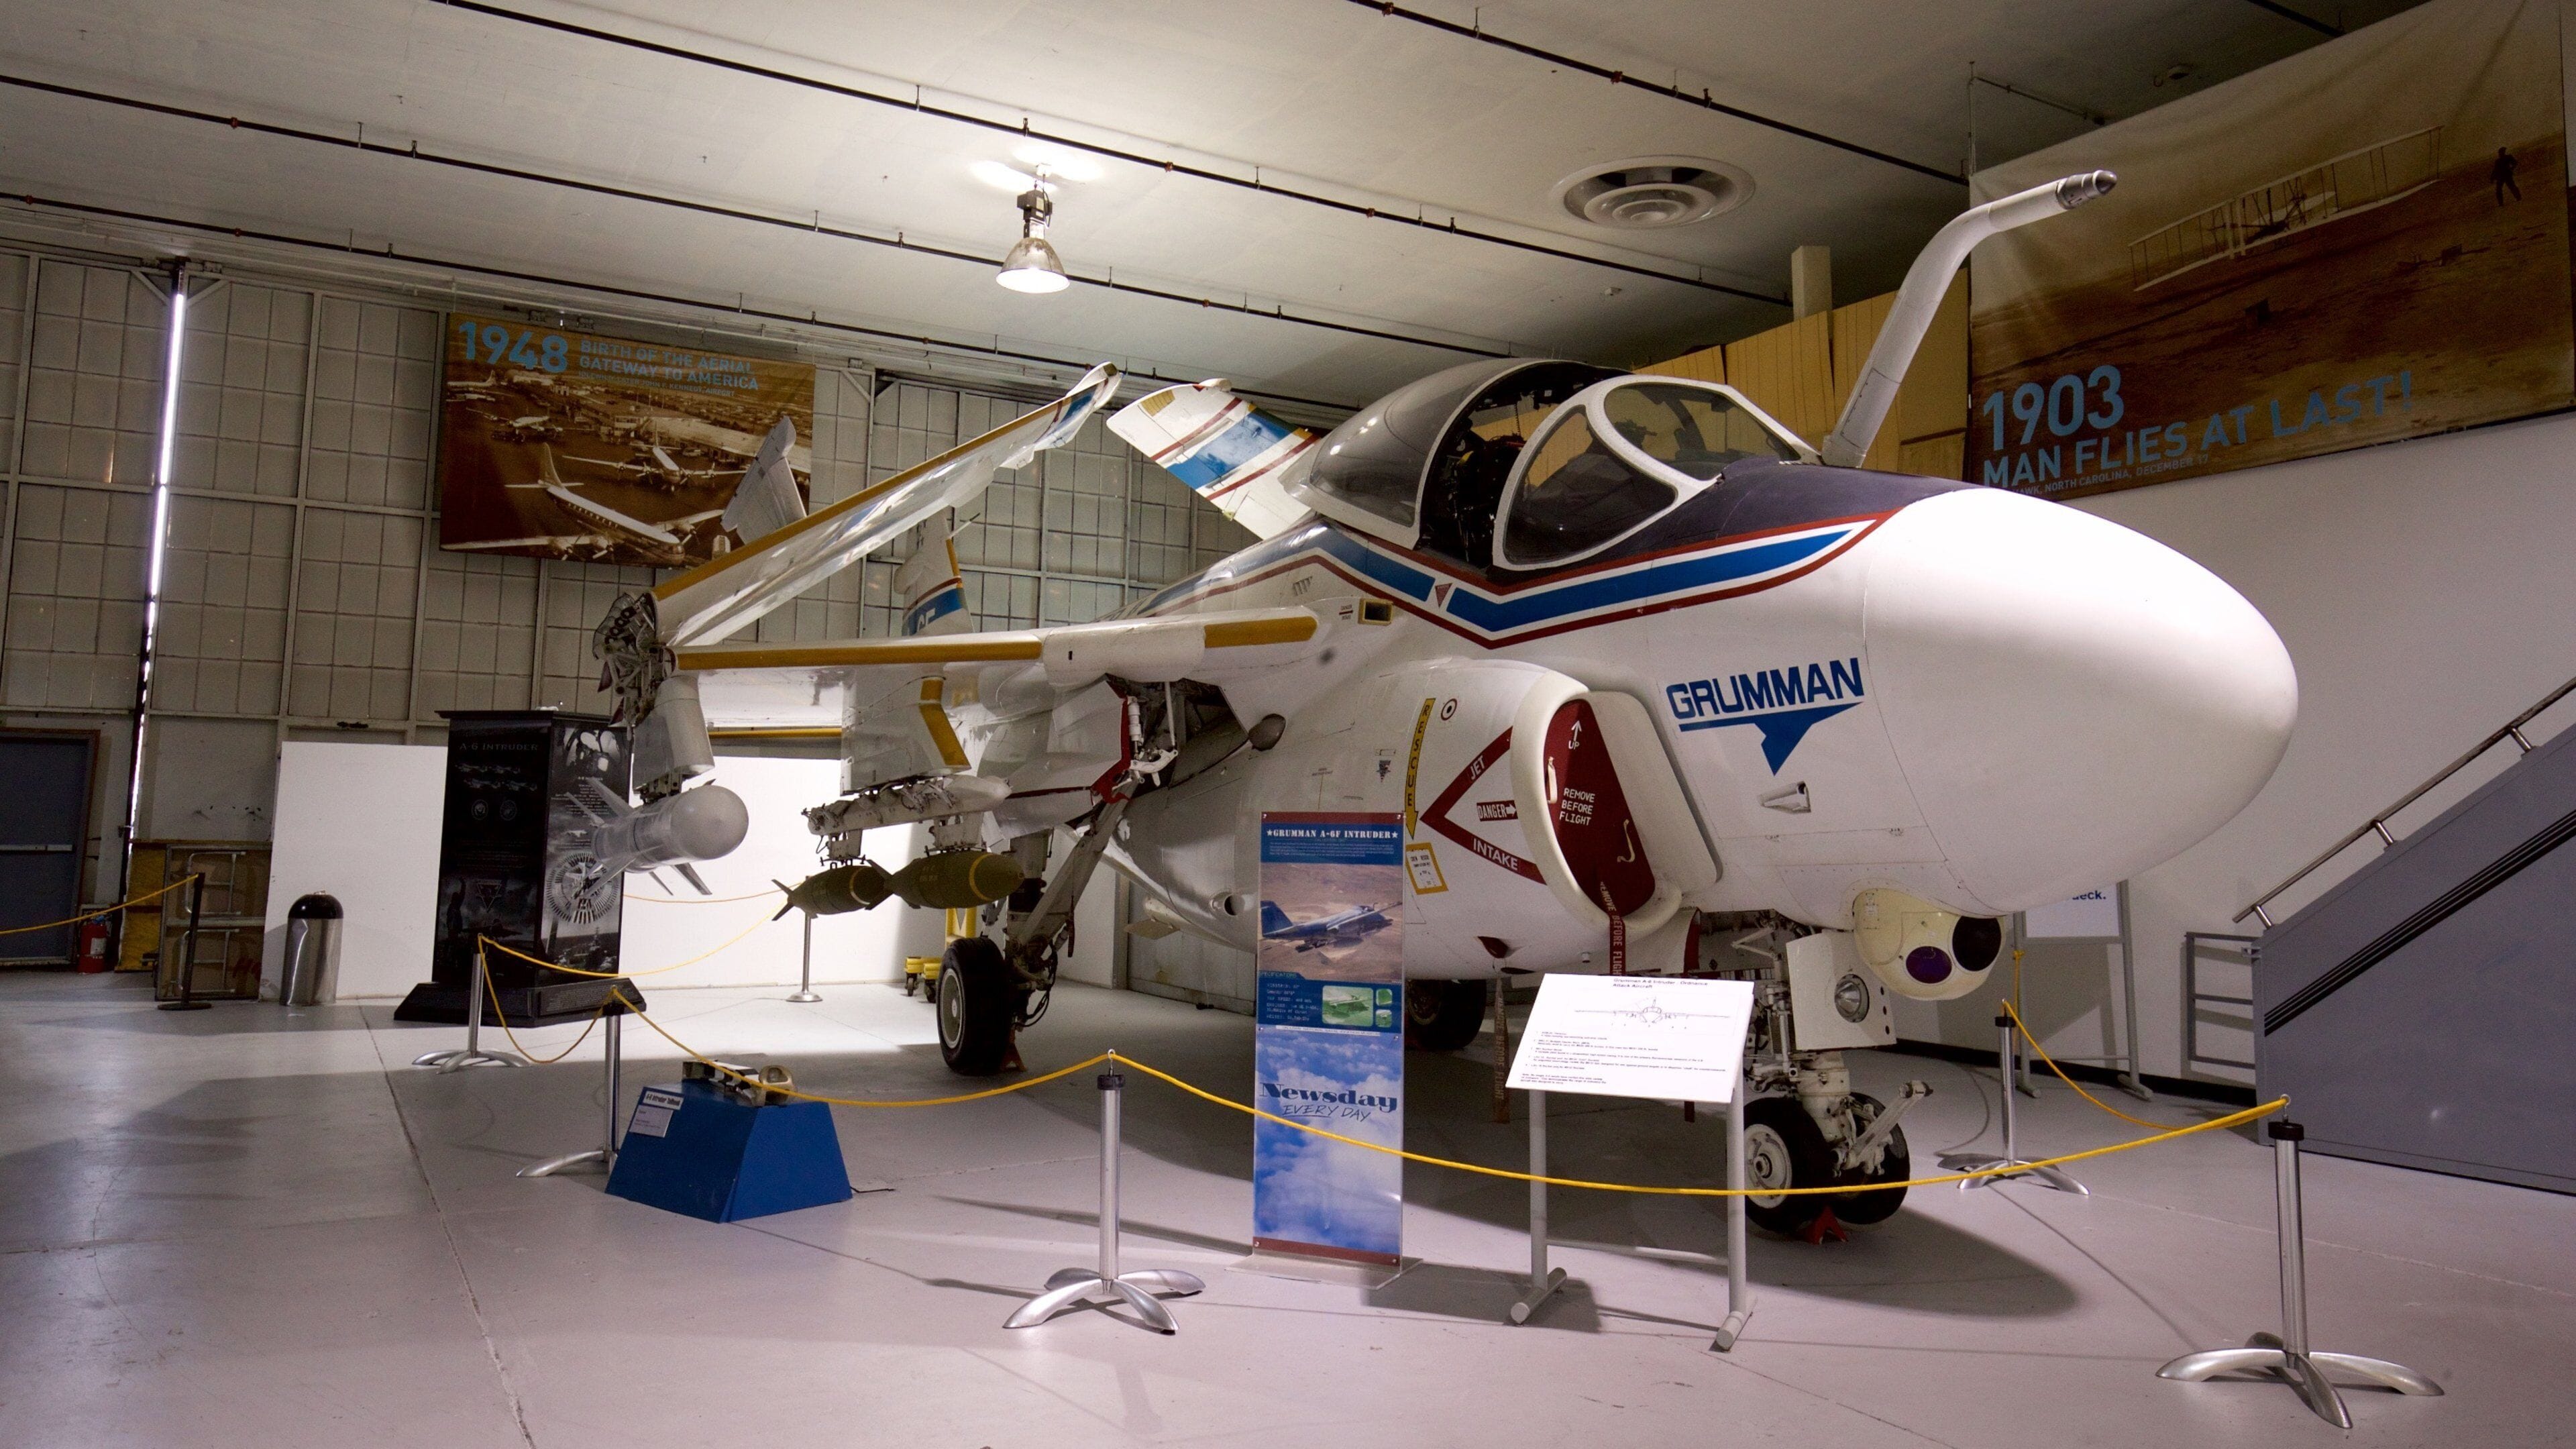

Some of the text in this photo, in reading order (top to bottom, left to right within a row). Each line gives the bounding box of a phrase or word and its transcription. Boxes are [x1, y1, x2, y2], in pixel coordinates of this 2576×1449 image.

[459, 321, 568, 373] 1948
[580, 339, 754, 374] BIRTH OF THE AERIAL
[580, 356, 759, 390] GATEWAY TO AMERICA
[642, 380, 659, 388] JOHN
[706, 388, 735, 397] AIRPORT
[1982, 365, 2125, 452] 1903
[1984, 371, 2412, 488] MAN FLIES AT LAST!
[2017, 485, 2043, 495] AWK,
[2045, 478, 2077, 492] NORTH
[2080, 470, 2133, 487] CAROLINA,
[2137, 457, 2193, 476] DECEMBER
[1666, 657, 1865, 720] GRUMMAN
[482, 743, 537, 751] INTRUDER
[1407, 704, 1431, 808] RESCUE
[1568, 740, 1580, 751] UP
[1469, 755, 1487, 781] JET
[1561, 800, 1594, 815] BEFORE
[1564, 787, 1596, 803] REMOVE
[1478, 804, 1507, 819] DANGER
[1560, 812, 1592, 826] FLIGHT
[1273, 829, 1316, 838] GRUMMAN
[1344, 830, 1391, 839] INTRUDER
[1472, 838, 1519, 871] INTAKE
[2072, 890, 2106, 900] eck.
[1612, 914, 1623, 947] BEFORE
[1613, 950, 1623, 975] FLIGH
[1495, 1035, 1505, 1067] BEFORE
[1259, 1083, 1397, 1113] Newsday
[1495, 1071, 1505, 1100] FLIGHT
[1282, 1104, 1371, 1122] EVERY DAY
